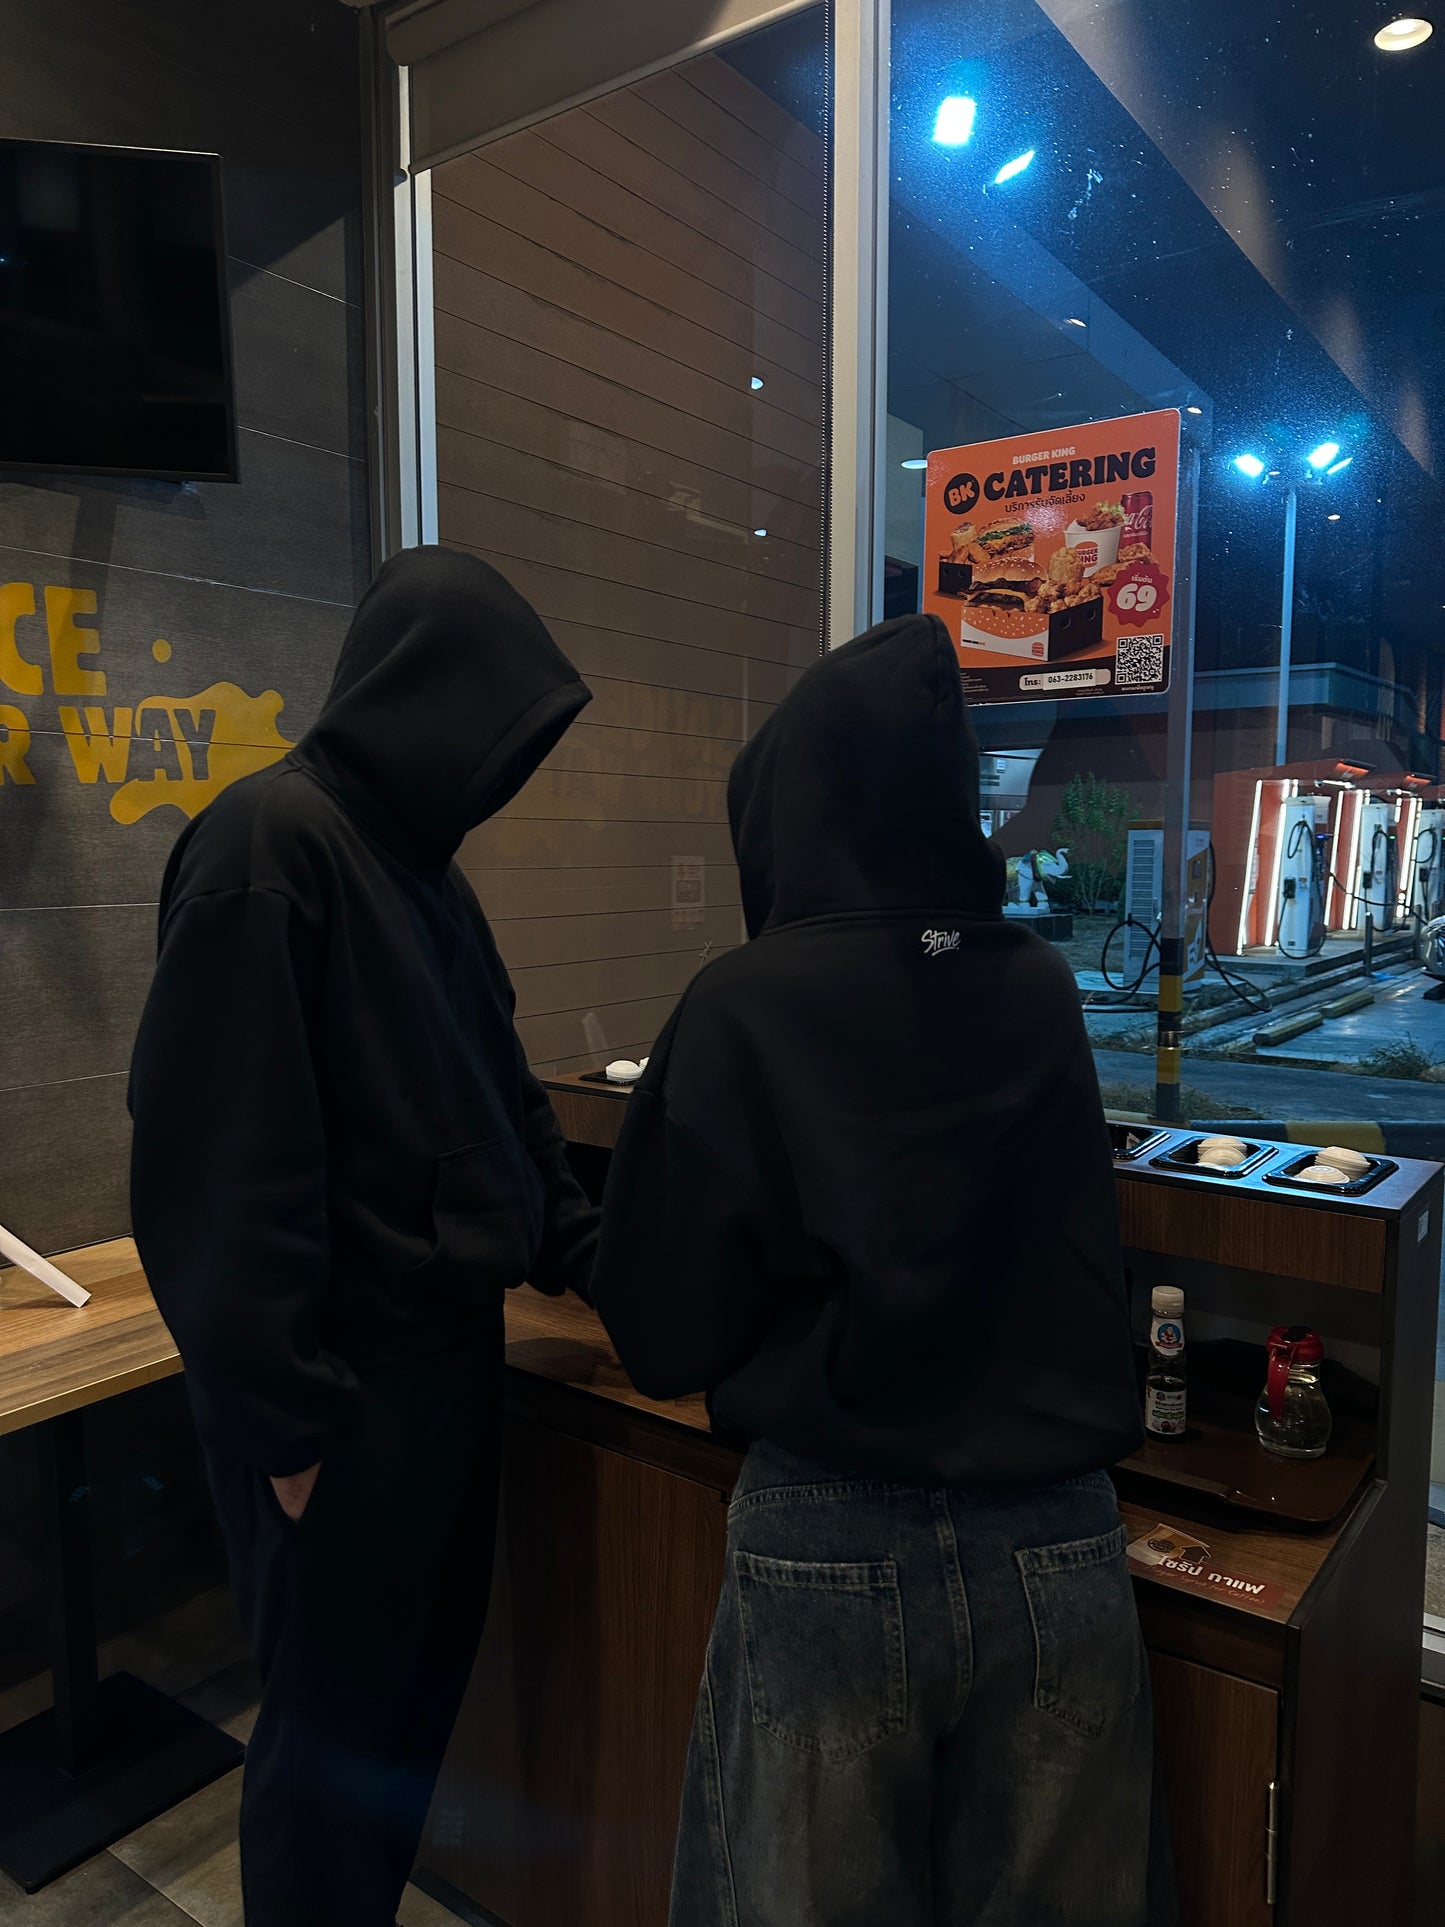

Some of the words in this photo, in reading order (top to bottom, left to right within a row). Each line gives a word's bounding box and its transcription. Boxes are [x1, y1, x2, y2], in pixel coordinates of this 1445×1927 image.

[1012, 451, 1049, 465] BURGER
[1051, 446, 1076, 459] KING
[983, 446, 1156, 501] CATERING
[948, 482, 976, 507] BK
[1048, 672, 1094, 684] 063-2283176
[58, 705, 217, 784] WAY
[1207, 1572, 1266, 1595] กาแฟ
